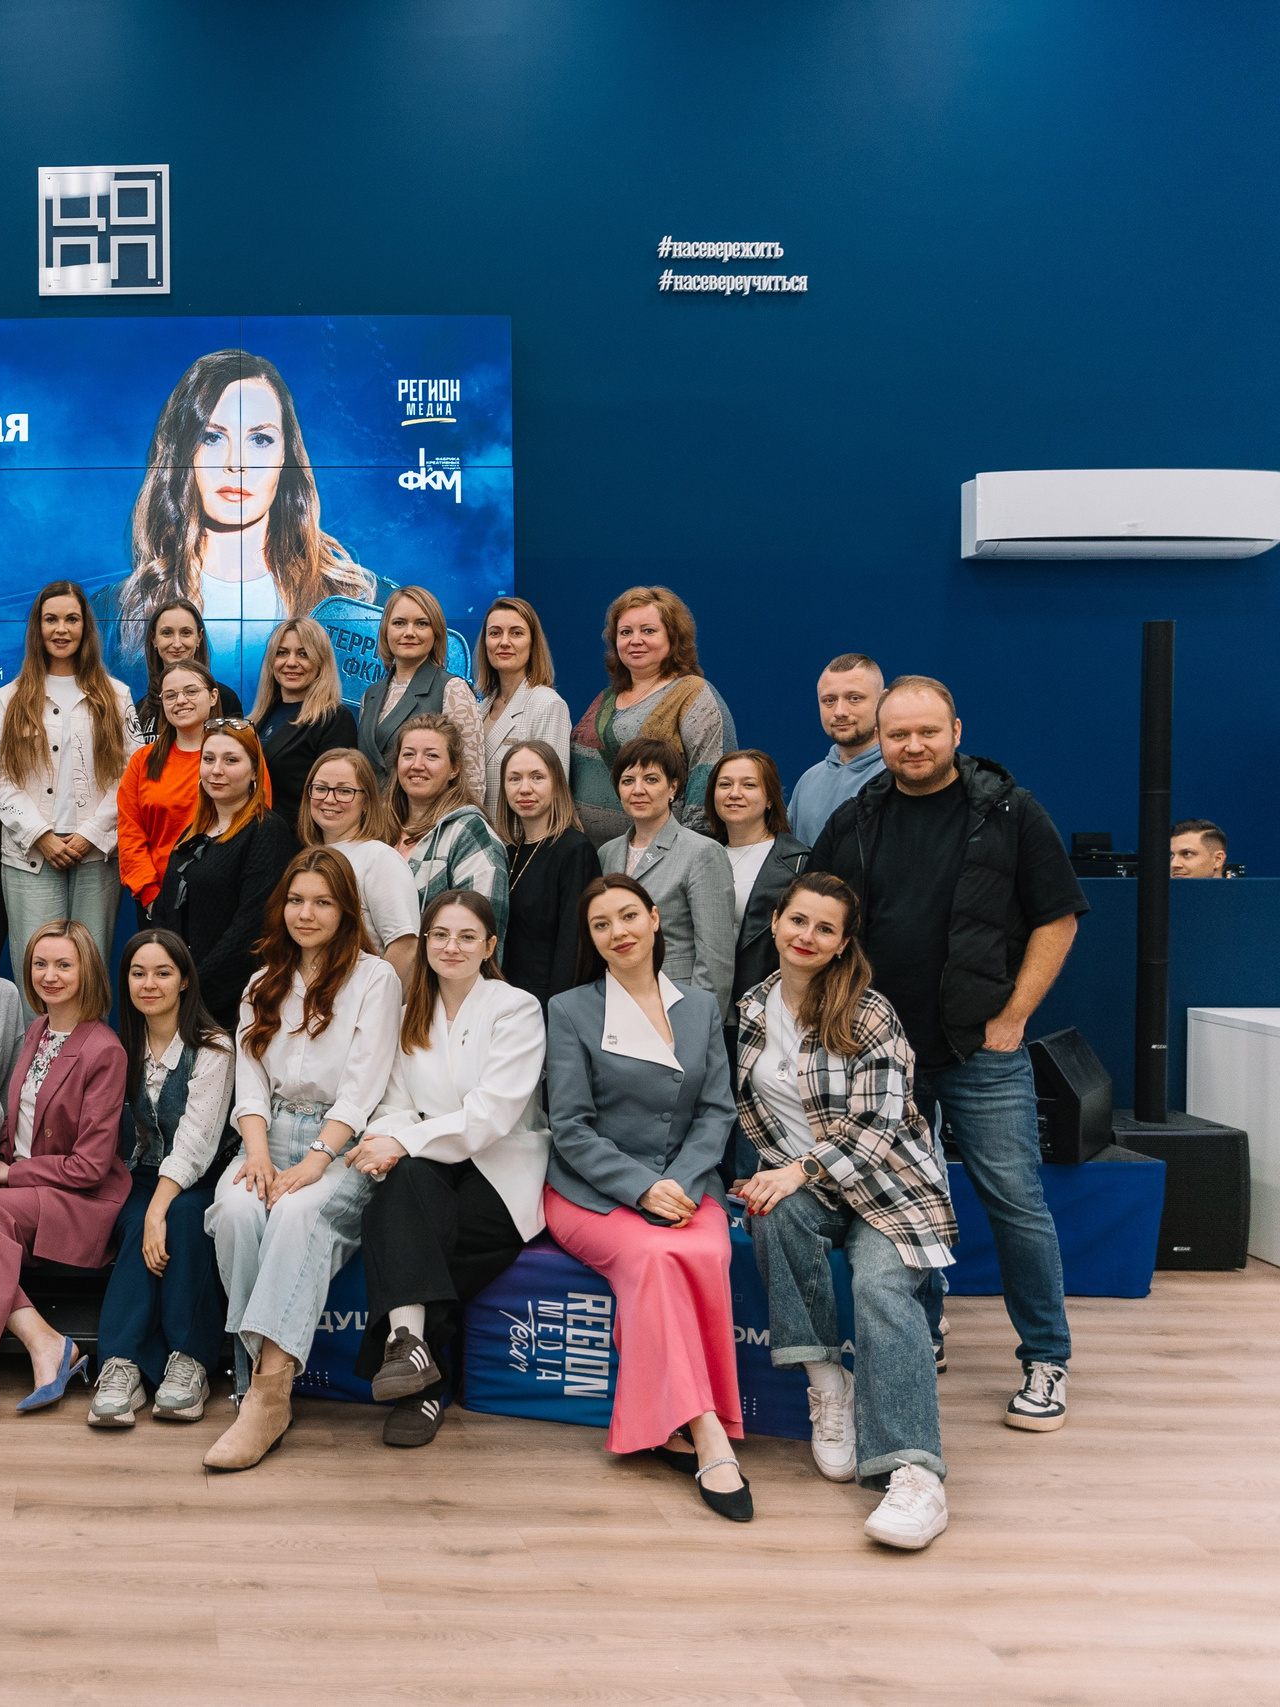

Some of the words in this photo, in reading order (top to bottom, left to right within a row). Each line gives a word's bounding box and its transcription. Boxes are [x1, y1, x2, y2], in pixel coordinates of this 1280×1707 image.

[657, 235, 784, 263] #насевережить
[658, 269, 808, 296] #насевереучиться
[398, 379, 460, 401] РЕГИОН
[406, 403, 452, 417] МЕДИА
[536, 1300, 564, 1380] MEDIA
[564, 1292, 612, 1399] REGION
